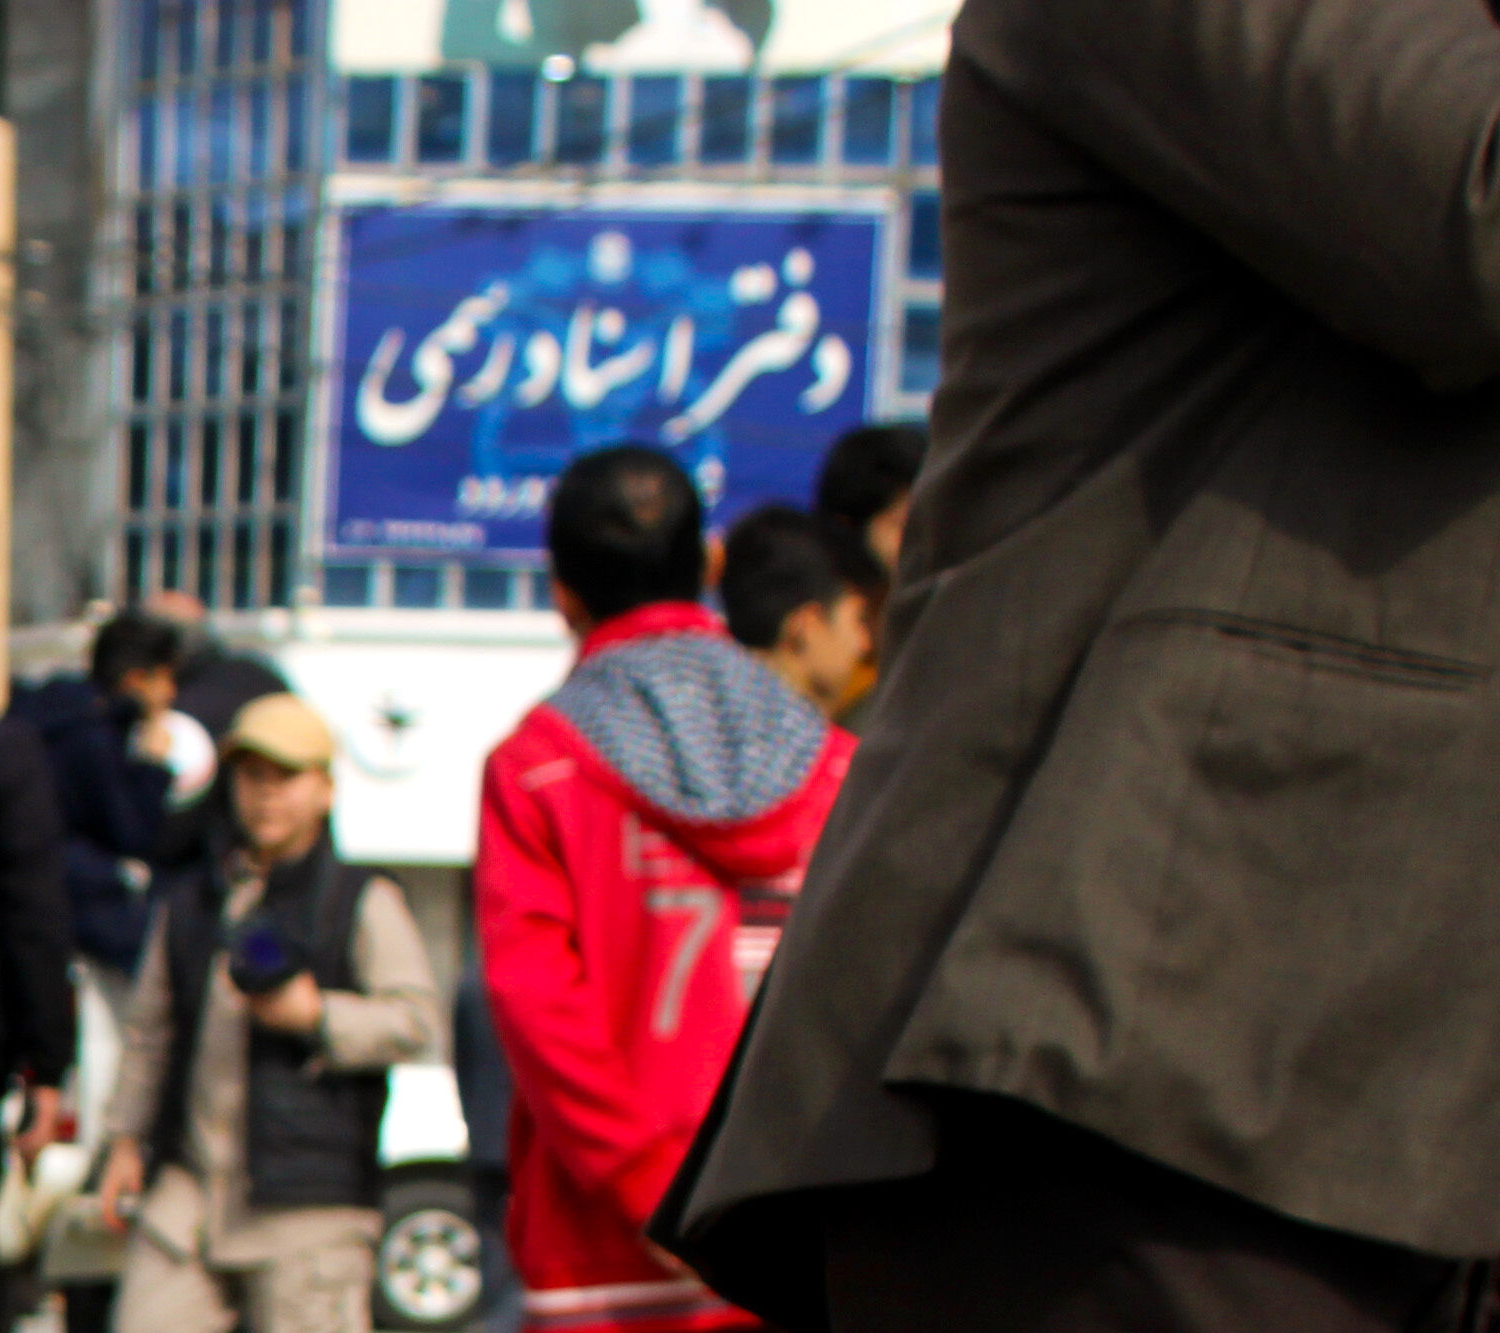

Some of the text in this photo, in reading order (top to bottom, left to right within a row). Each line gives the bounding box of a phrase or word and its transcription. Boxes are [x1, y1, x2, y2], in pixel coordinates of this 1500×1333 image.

[355, 246, 852, 447] دفتر اسناد رسمی
